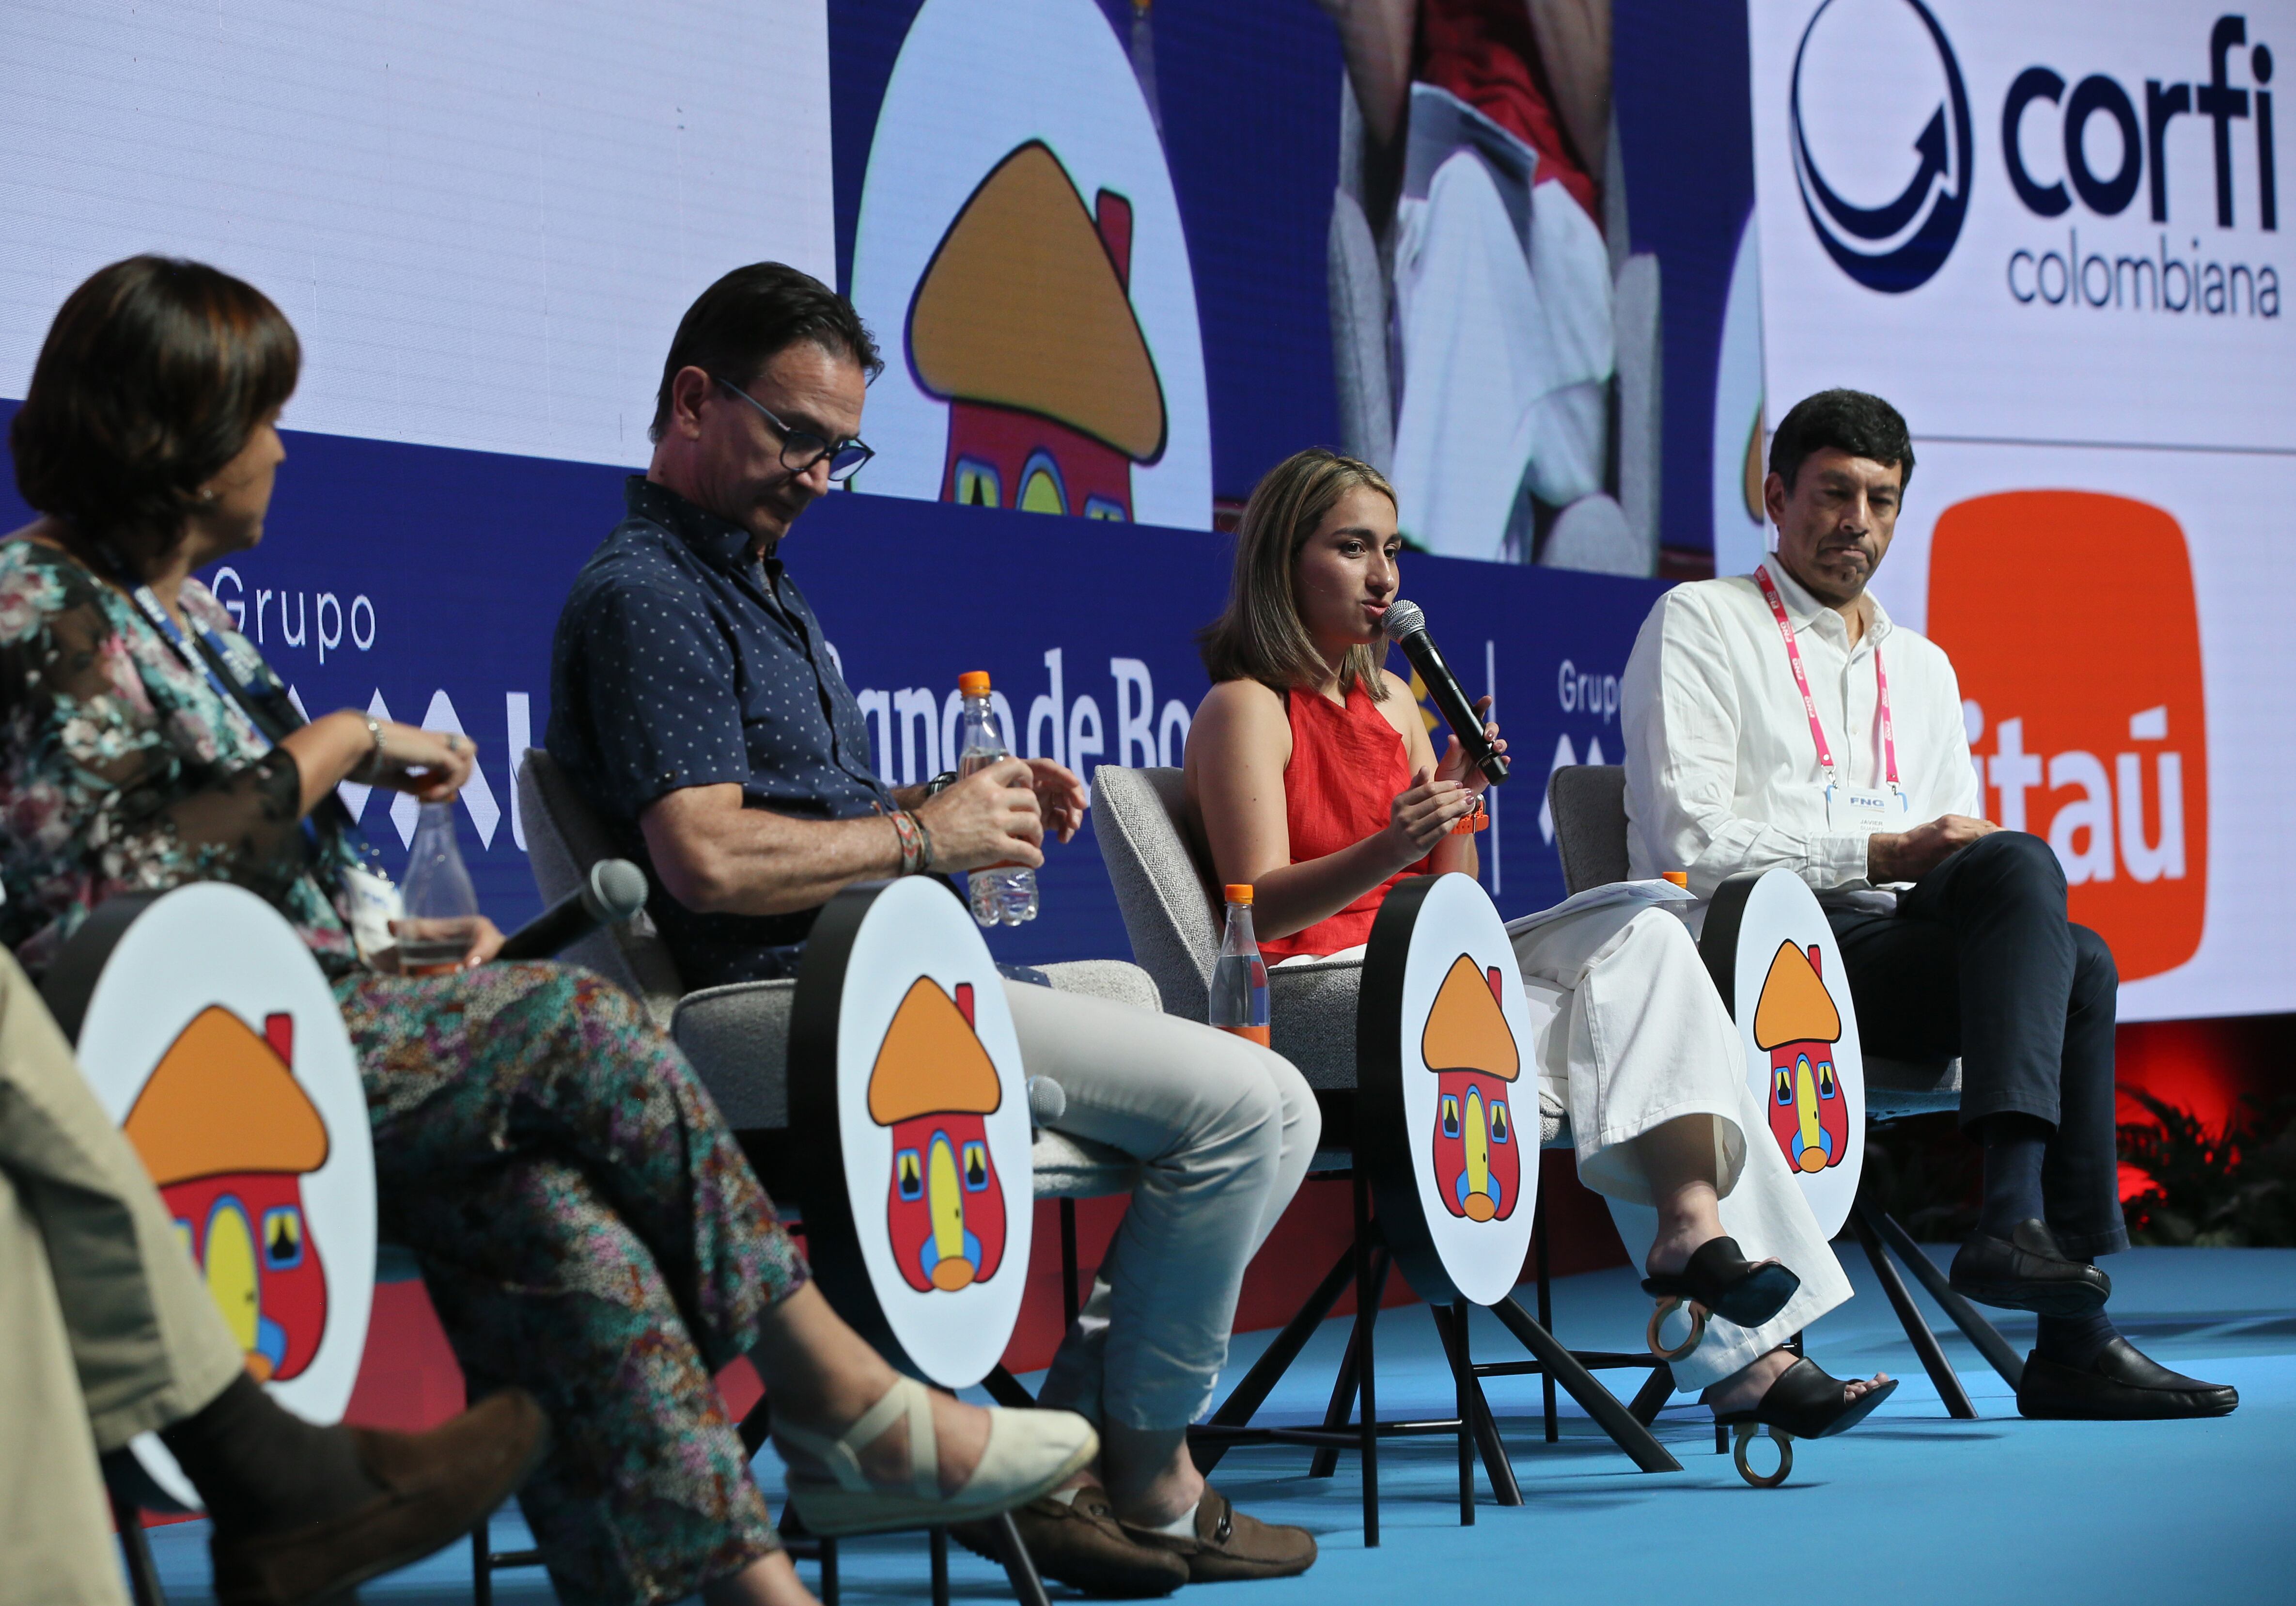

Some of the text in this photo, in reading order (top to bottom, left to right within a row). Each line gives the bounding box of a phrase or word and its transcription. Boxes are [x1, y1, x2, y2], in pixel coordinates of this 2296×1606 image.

[2002, 15, 2278, 232] corfi
[2008, 228, 2280, 319] colombiana
[211, 566, 376, 664] Grupo
[1781, 622, 1793, 643] FNG
[1558, 659, 1624, 725] Grup
[1792, 658, 1804, 680] FNG
[1027, 647, 1104, 807] de
[1850, 797, 1884, 806] FNG
